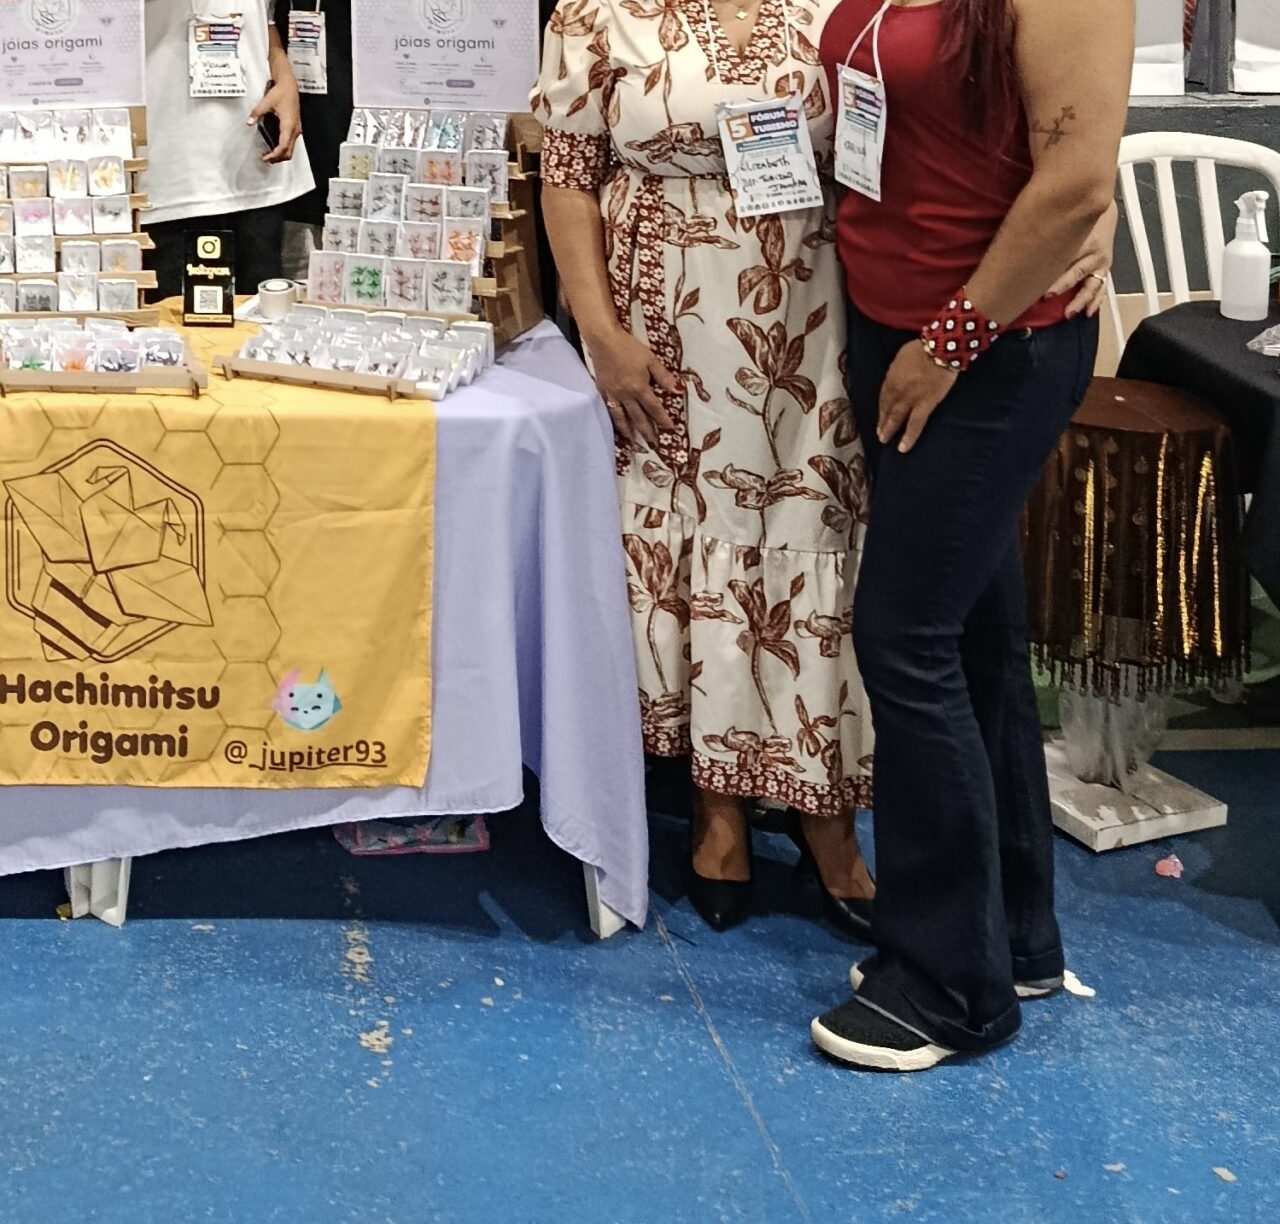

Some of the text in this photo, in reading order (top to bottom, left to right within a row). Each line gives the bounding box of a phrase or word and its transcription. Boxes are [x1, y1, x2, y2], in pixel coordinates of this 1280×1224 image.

[1, 34, 103, 55] jóias origami
[394, 34, 495, 53] jóias origami
[29, 720, 189, 765] Origami
